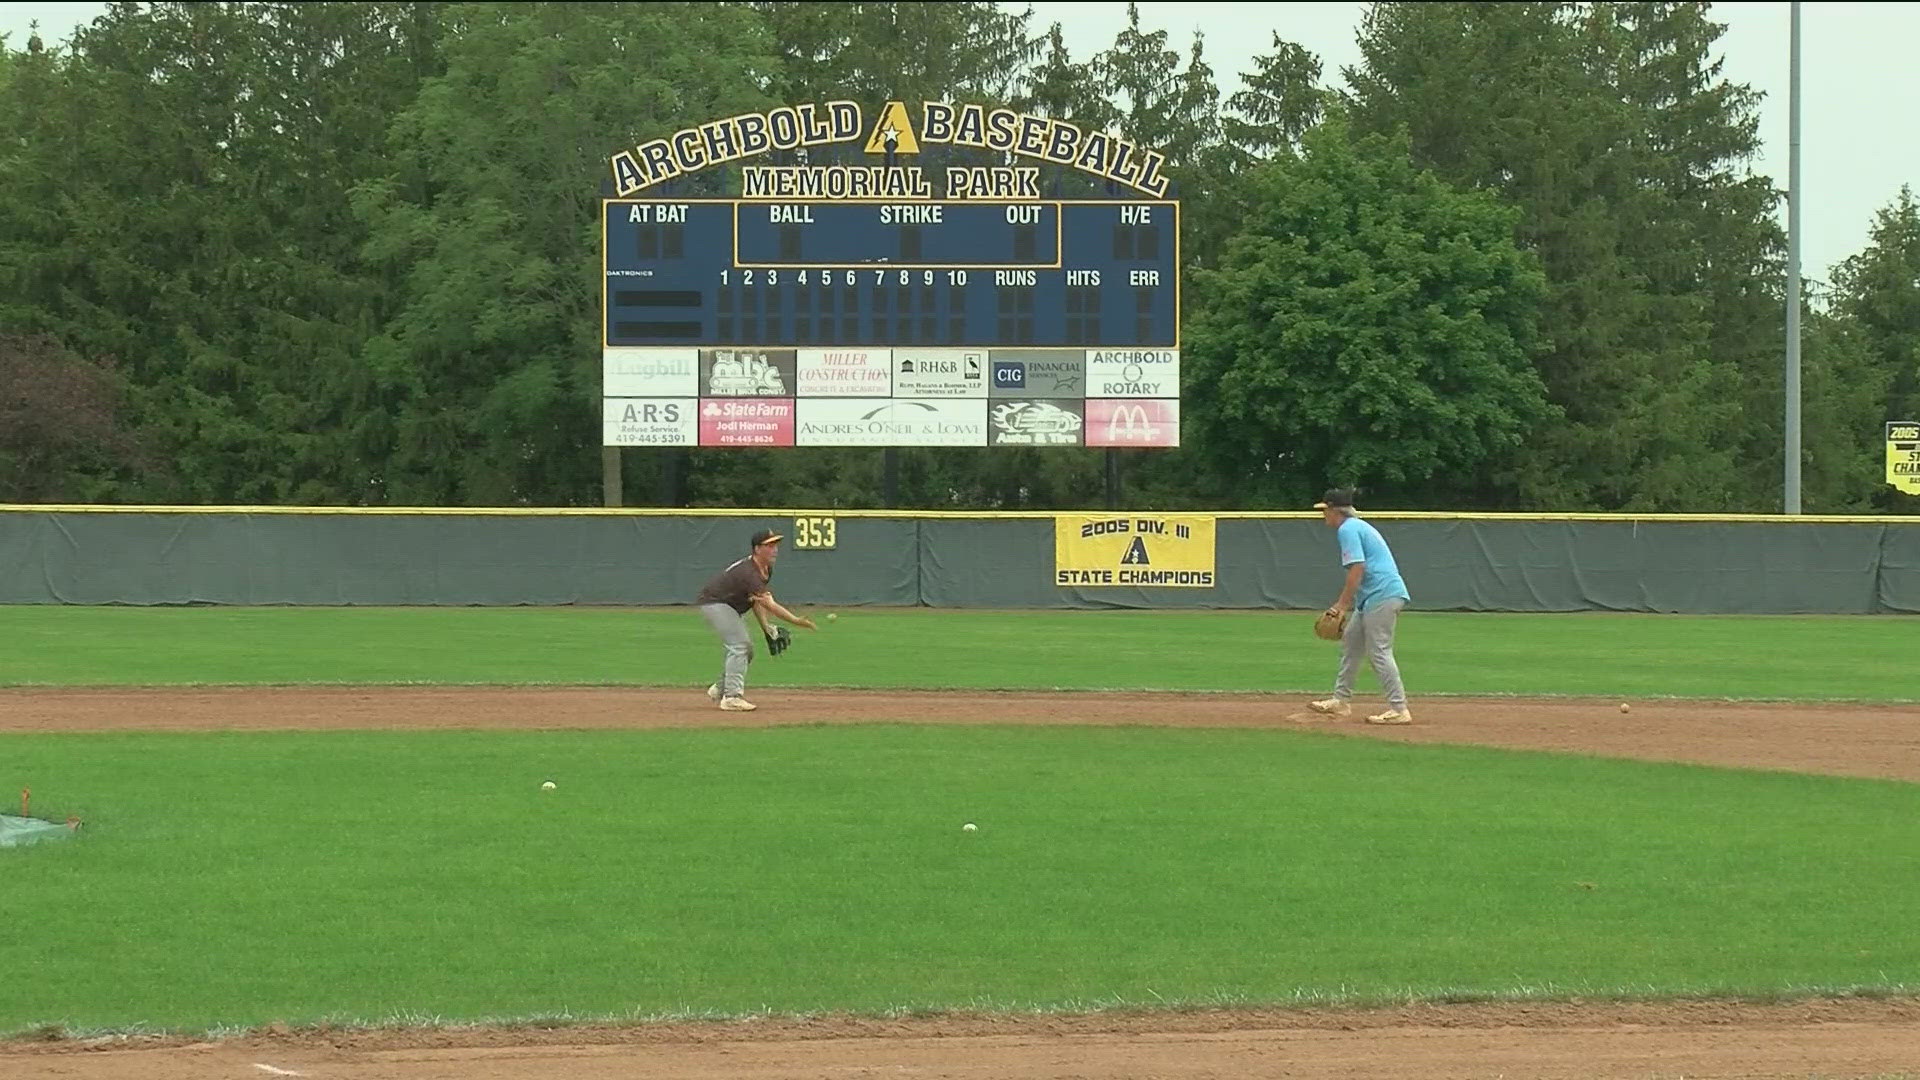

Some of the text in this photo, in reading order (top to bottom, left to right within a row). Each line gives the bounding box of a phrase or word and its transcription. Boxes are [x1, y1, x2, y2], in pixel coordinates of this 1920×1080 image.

[611, 100, 862, 197] ARCHBOLD
[921, 101, 1170, 198] BASEBALL
[742, 166, 1040, 199] MEMORIAL PARK
[629, 204, 688, 223] AT BAT
[770, 205, 814, 224] BALL
[879, 205, 943, 224] STRIKE
[1006, 205, 1042, 224] OUT
[1121, 206, 1151, 225] H/E
[720, 270, 1160, 286] 1 2 3 4 5 6 7 8 9 10 RUNS HITS ERR
[822, 353, 868, 366] MILLER
[1093, 352, 1173, 364] ARCHBOLD
[920, 361, 958, 373] RH&B
[1029, 362, 1081, 372] FINANCIAL
[798, 368, 889, 381] CONSTRUCTION
[997, 368, 1022, 382] CIG
[1103, 382, 1161, 394] ROTARY
[621, 425, 679, 434] Refuse Service
[716, 421, 779, 431] Jodi Herman
[800, 421, 864, 434] ANDRES
[922, 425, 933, 434] &
[938, 421, 981, 434] LOWE
[1890, 427, 1920, 439] 2005
[615, 434, 686, 443] 419-445-5391
[795, 517, 836, 547] 353
[1081, 519, 1190, 539] 2005 DIV. III
[1058, 570, 1213, 585] STATE CHAMPIONS
